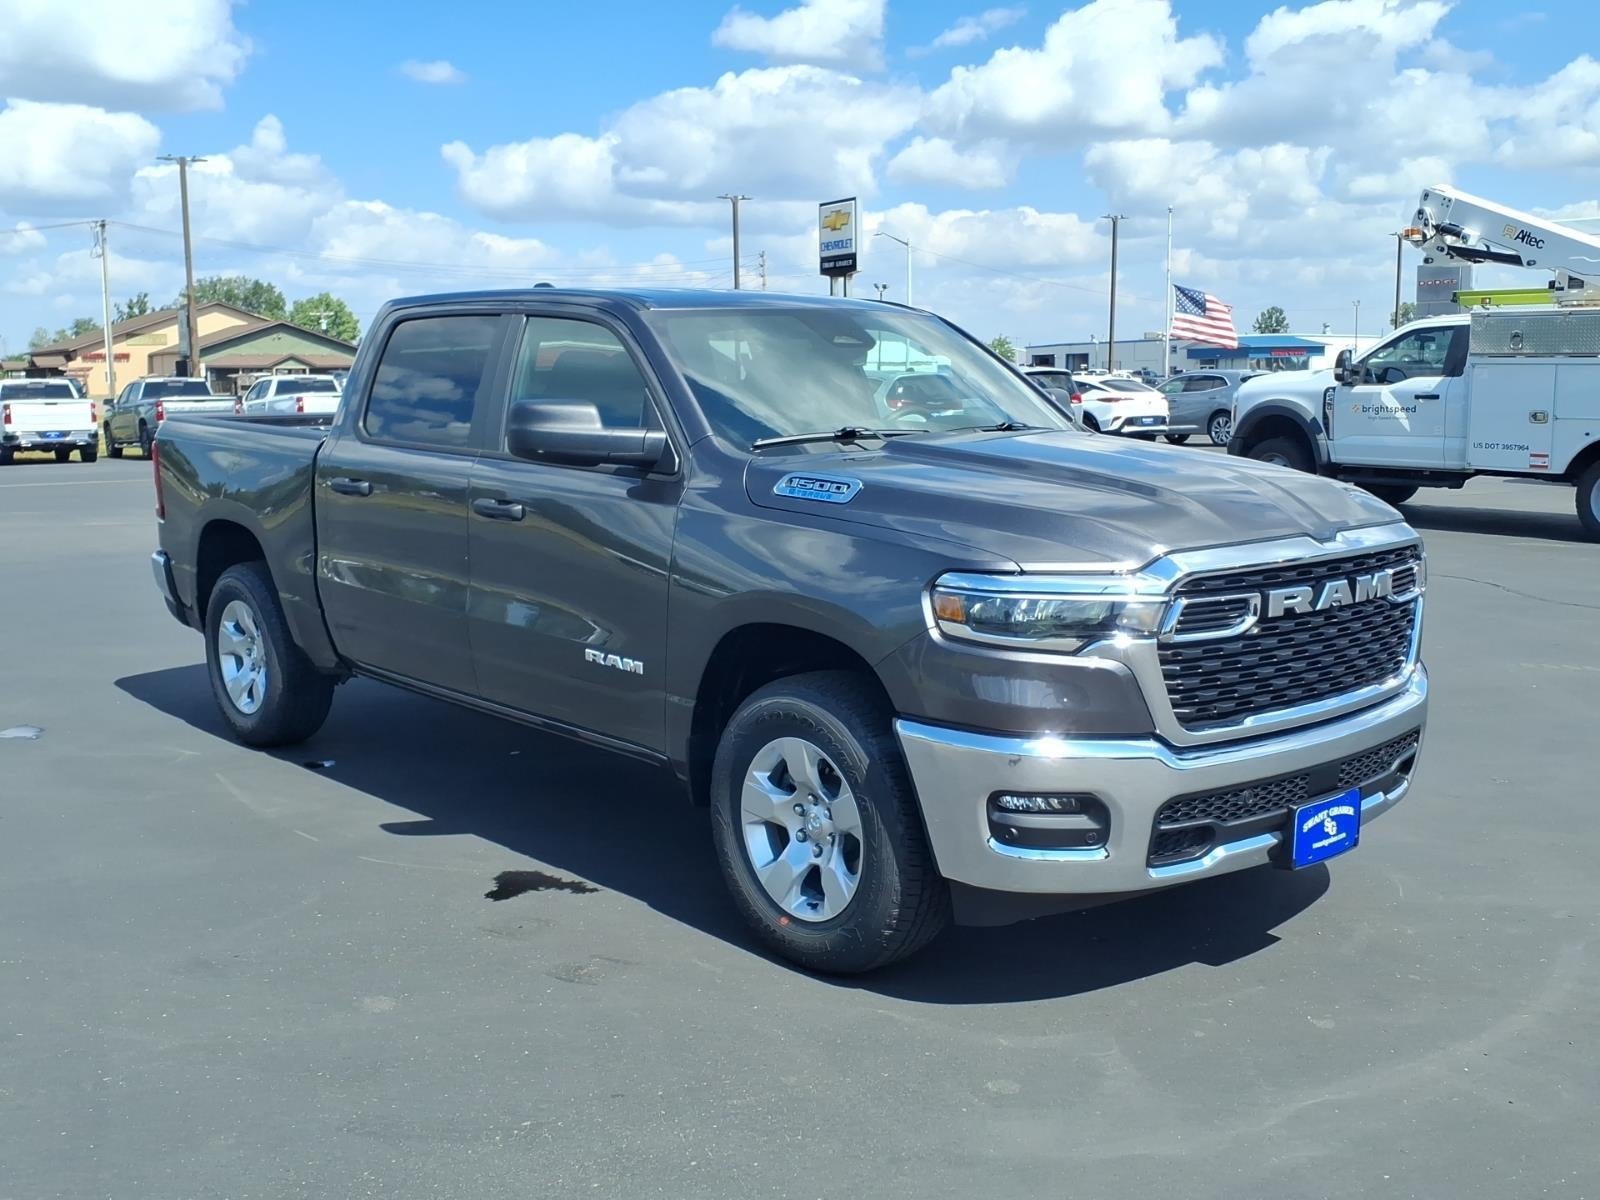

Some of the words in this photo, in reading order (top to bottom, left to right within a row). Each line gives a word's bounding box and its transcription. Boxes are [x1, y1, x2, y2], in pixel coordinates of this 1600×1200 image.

[820, 238, 853, 252] CHEVROLET
[1514, 229, 1545, 249] Altec
[1418, 279, 1457, 287] DODGE
[1361, 404, 1417, 416] brightspeed
[1484, 442, 1500, 450] DOT
[784, 477, 849, 495] 1500
[1268, 571, 1393, 618] RAM
[585, 648, 644, 675] RAM
